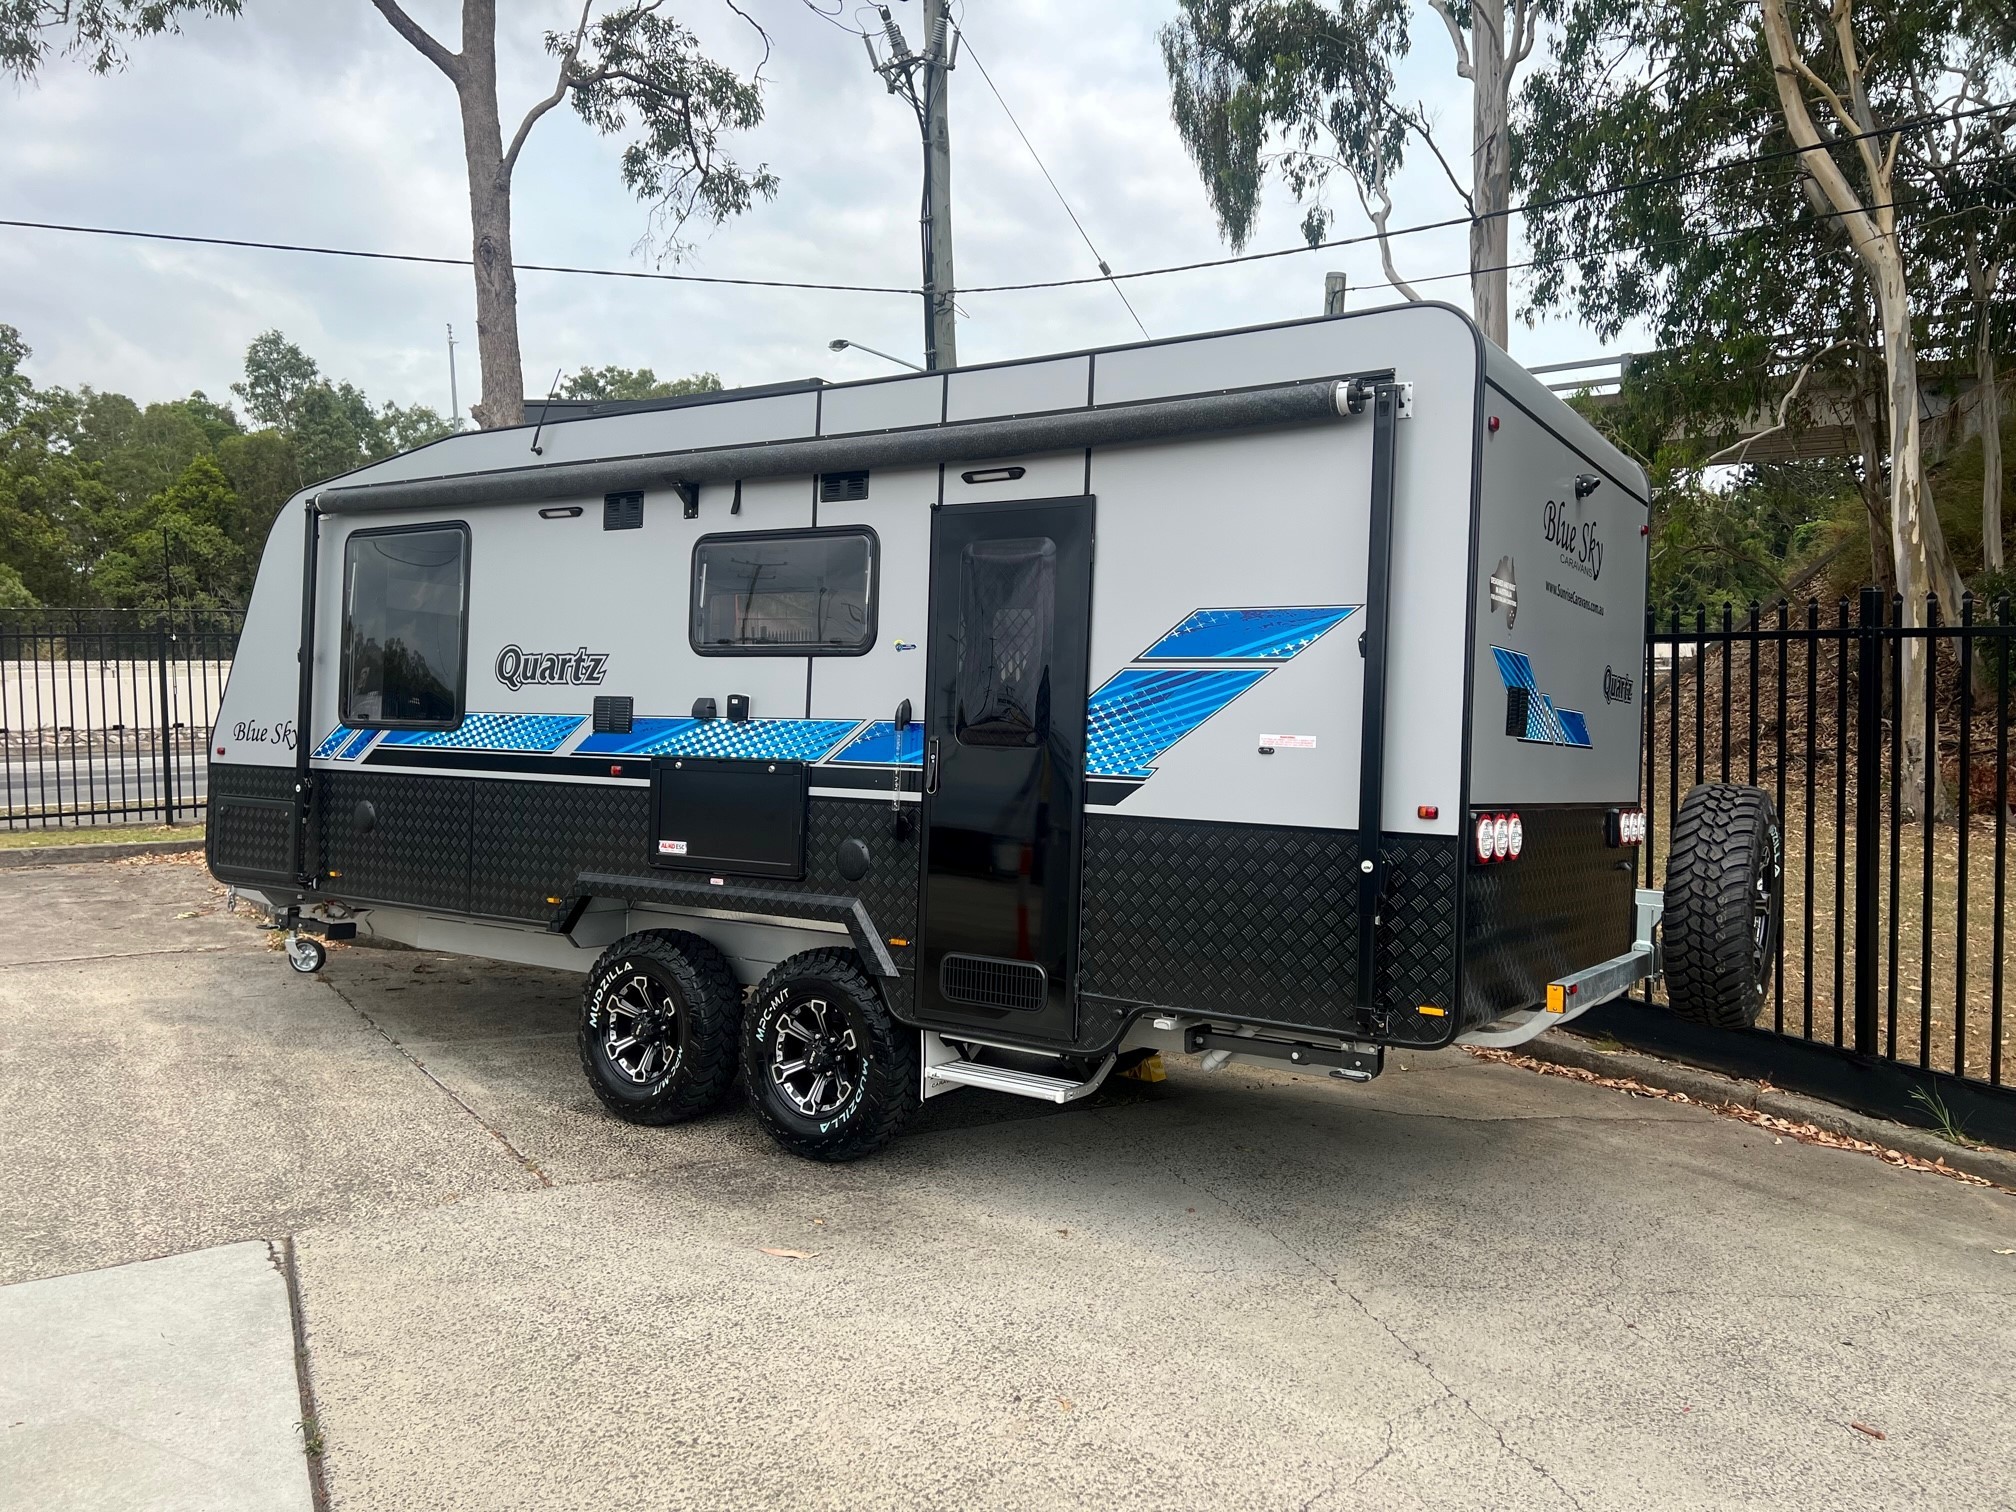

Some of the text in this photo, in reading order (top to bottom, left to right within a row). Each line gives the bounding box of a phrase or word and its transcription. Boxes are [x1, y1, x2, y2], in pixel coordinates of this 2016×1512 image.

[1543, 500, 1604, 581] Blue Sky
[1560, 553, 1593, 578] CARAVANS
[1545, 580, 1604, 616] www.SunriseCaravans.com.au
[495, 644, 610, 691] Quartz
[1603, 664, 1634, 705] Quartz
[233, 719, 299, 750] Blue Sky
[588, 961, 634, 1029] MUDZILLA
[819, 1057, 869, 1134] MUDZILLA
